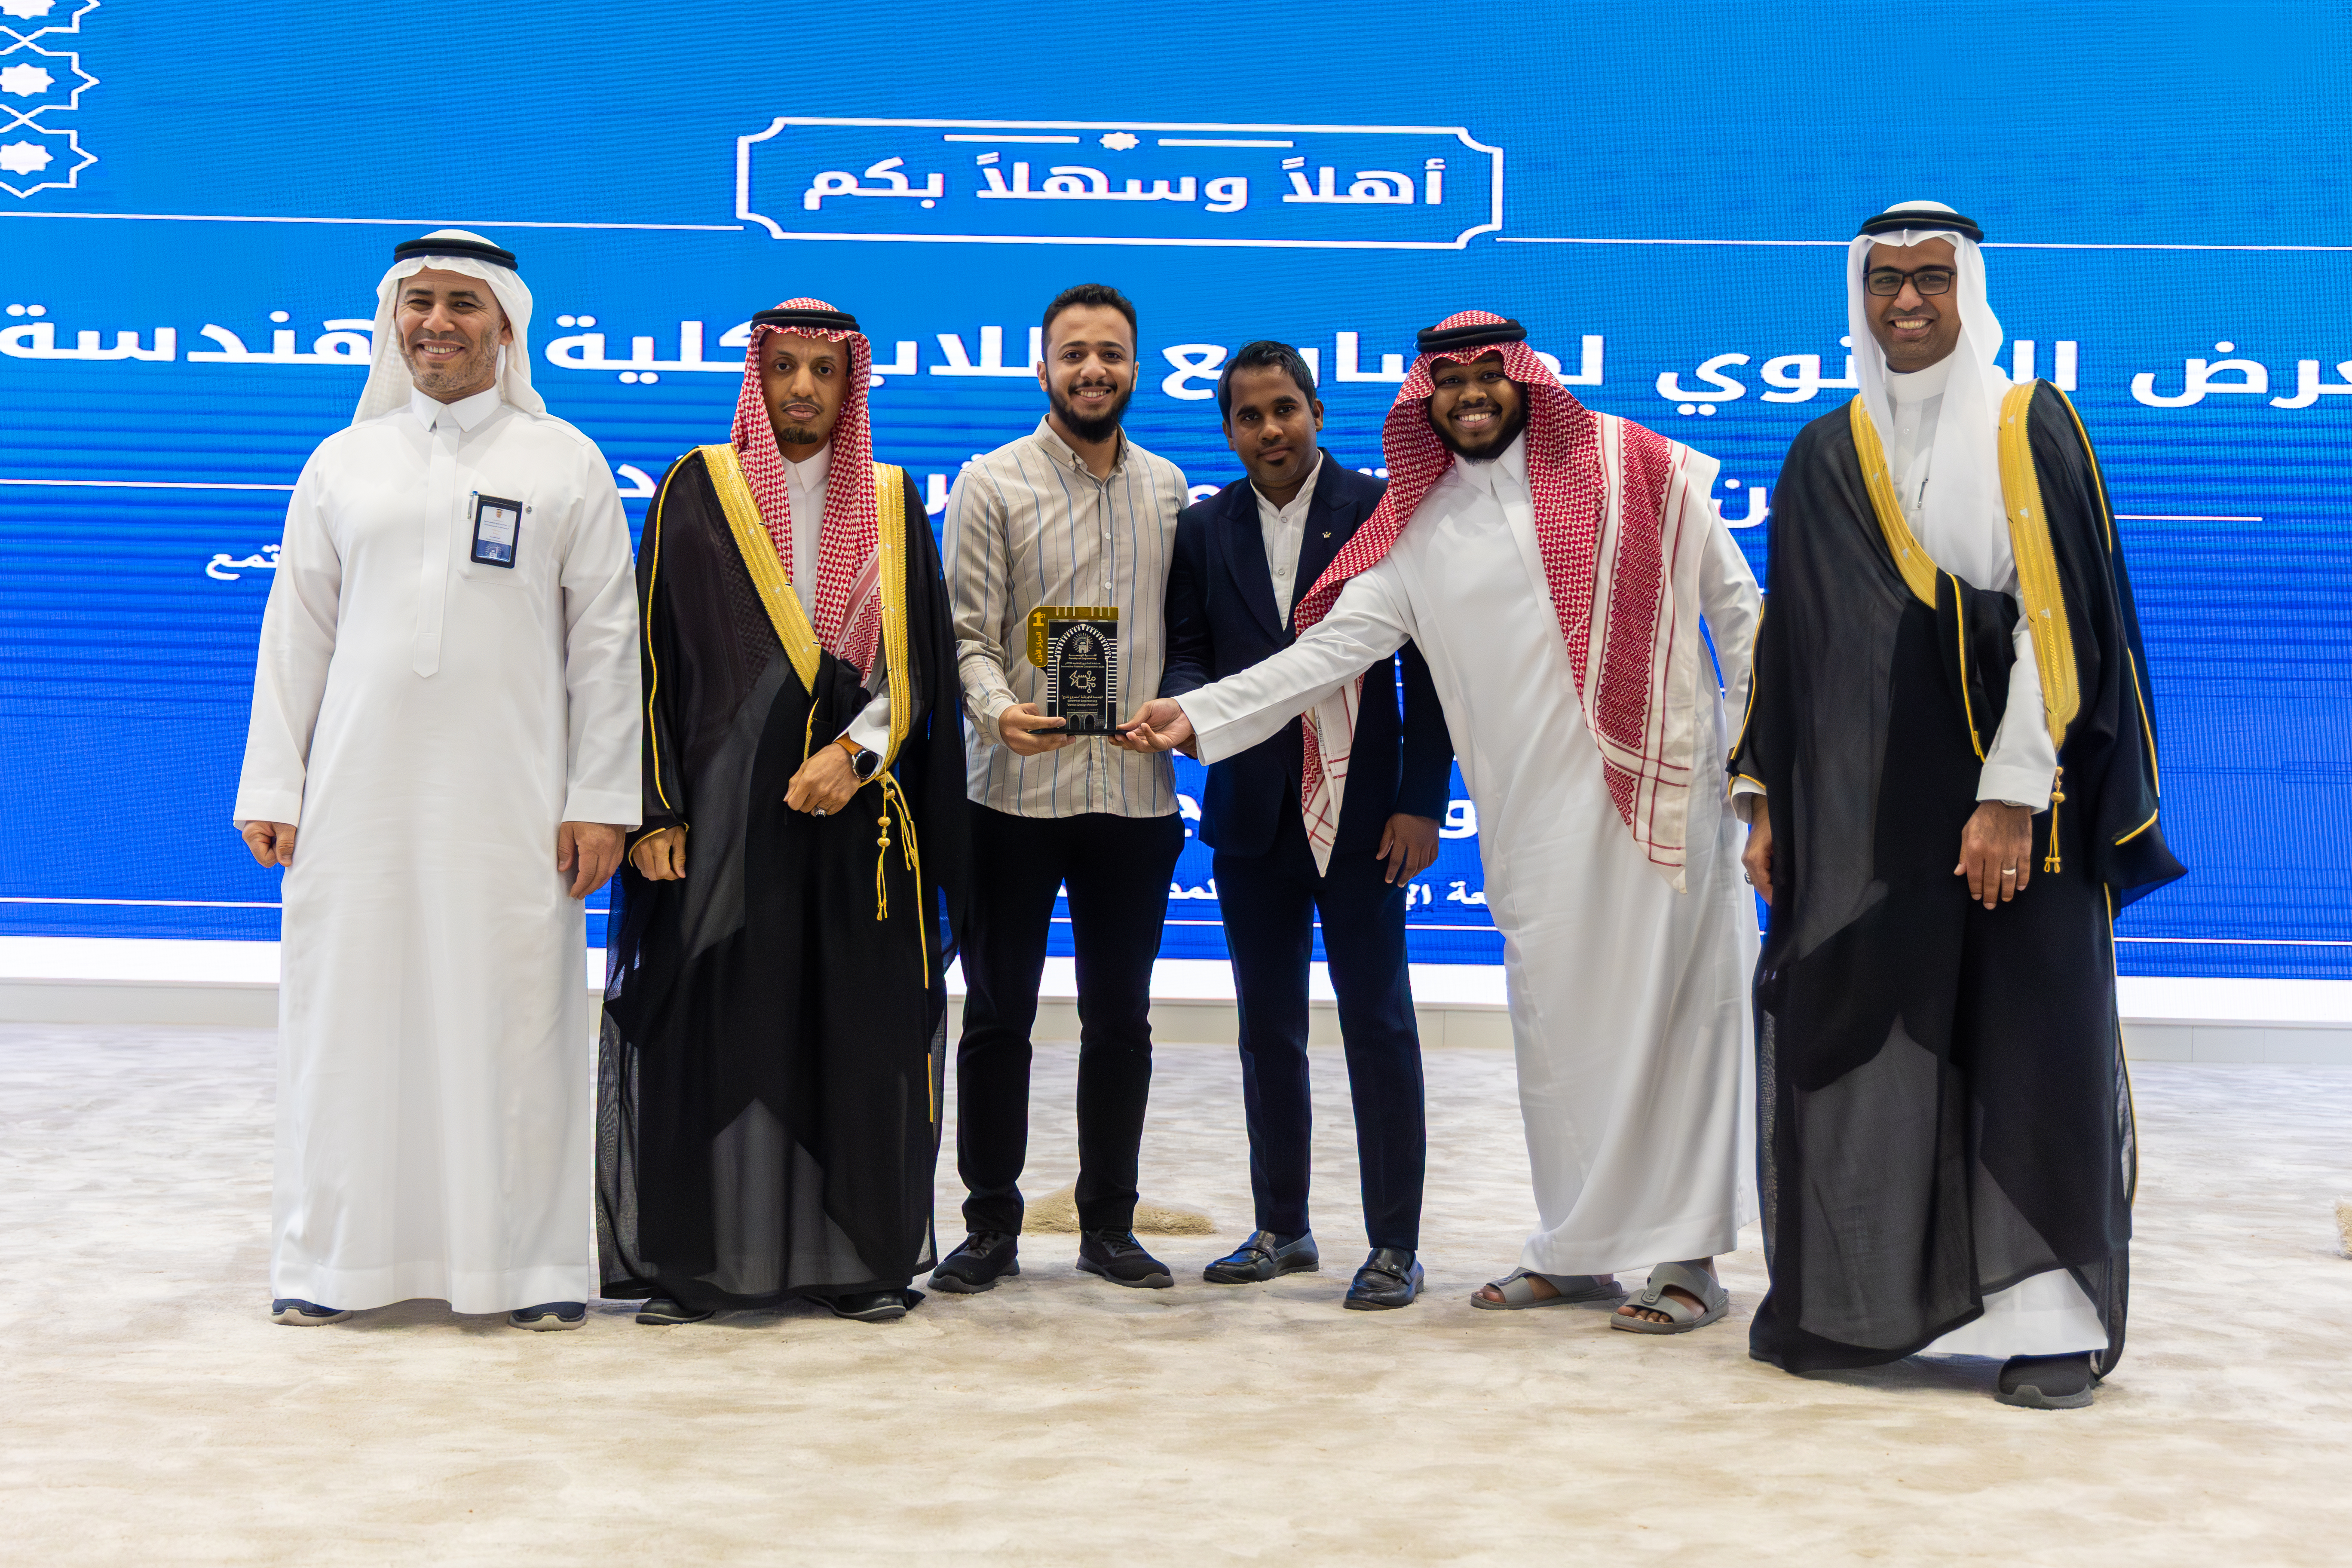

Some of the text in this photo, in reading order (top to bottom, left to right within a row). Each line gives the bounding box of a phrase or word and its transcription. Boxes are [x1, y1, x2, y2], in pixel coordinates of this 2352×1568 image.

[804, 152, 1446, 212] أهلاً وسهلاً بكم
[0, 303, 375, 365] هندسة
